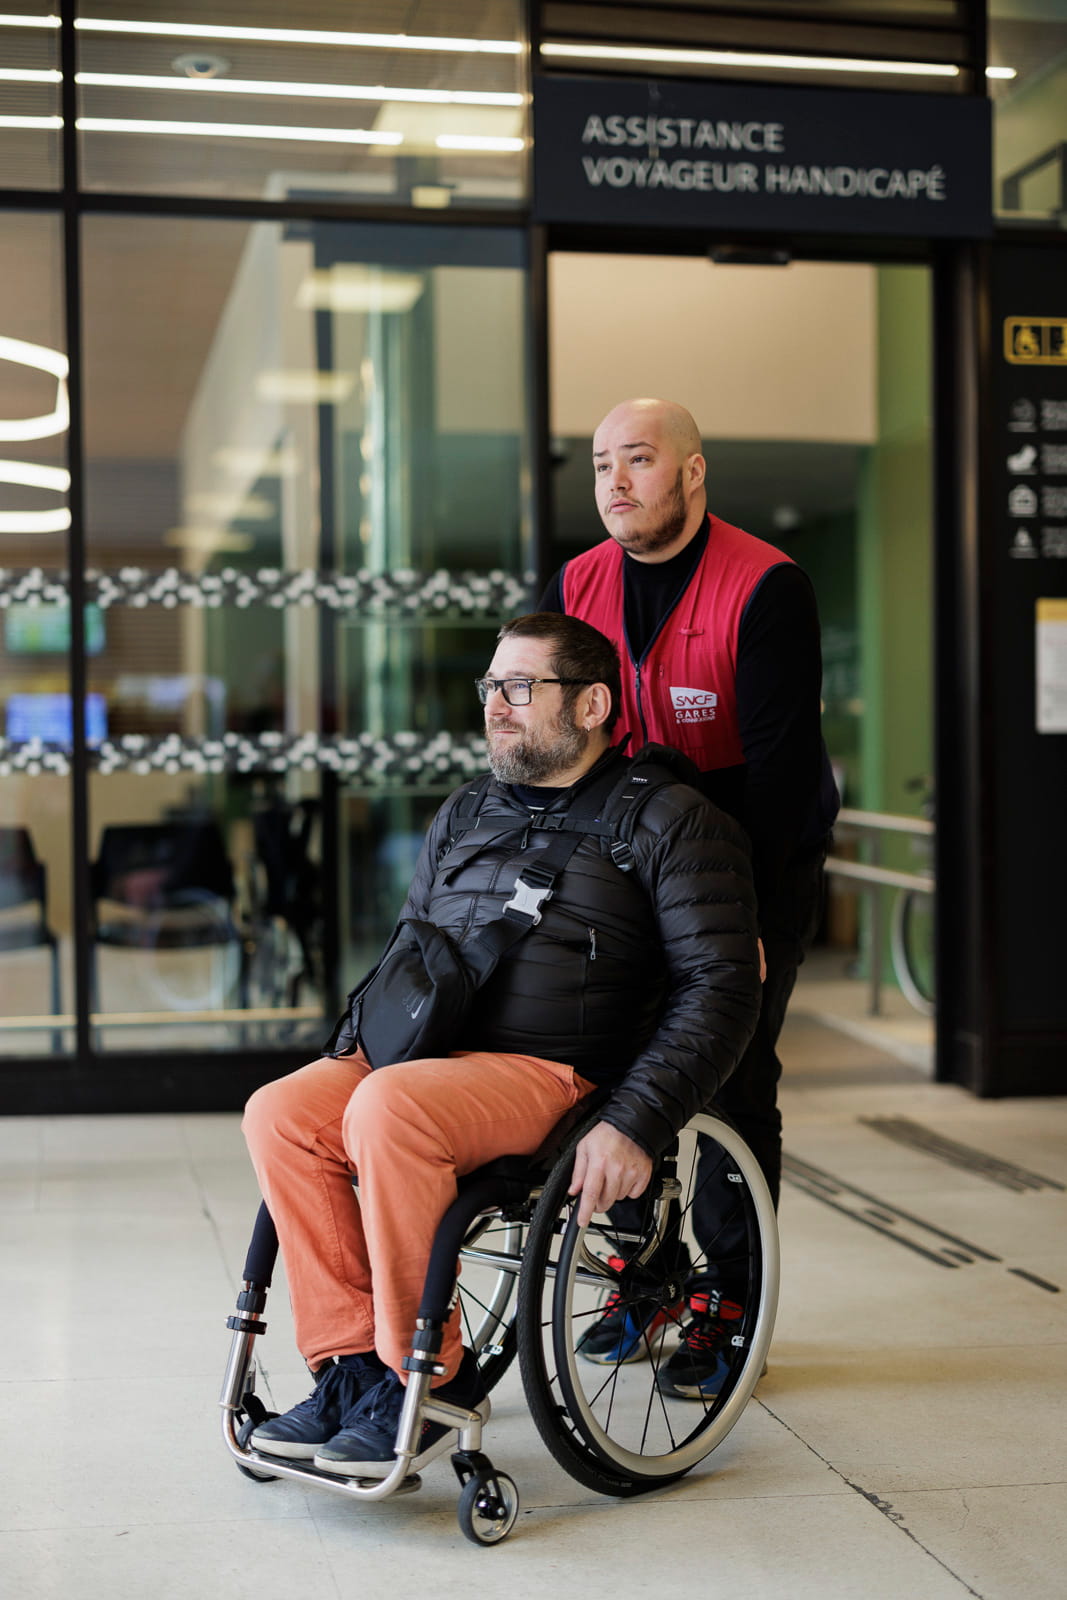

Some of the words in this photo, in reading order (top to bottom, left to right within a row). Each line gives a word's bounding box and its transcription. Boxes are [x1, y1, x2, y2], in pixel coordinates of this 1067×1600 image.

[582, 115, 785, 152] ASSISTANCE
[582, 157, 759, 193] VOYAGEUR
[765, 163, 947, 200] HANDICAPÉ
[676, 695, 713, 706] SNCF
[675, 708, 716, 719] GARES
